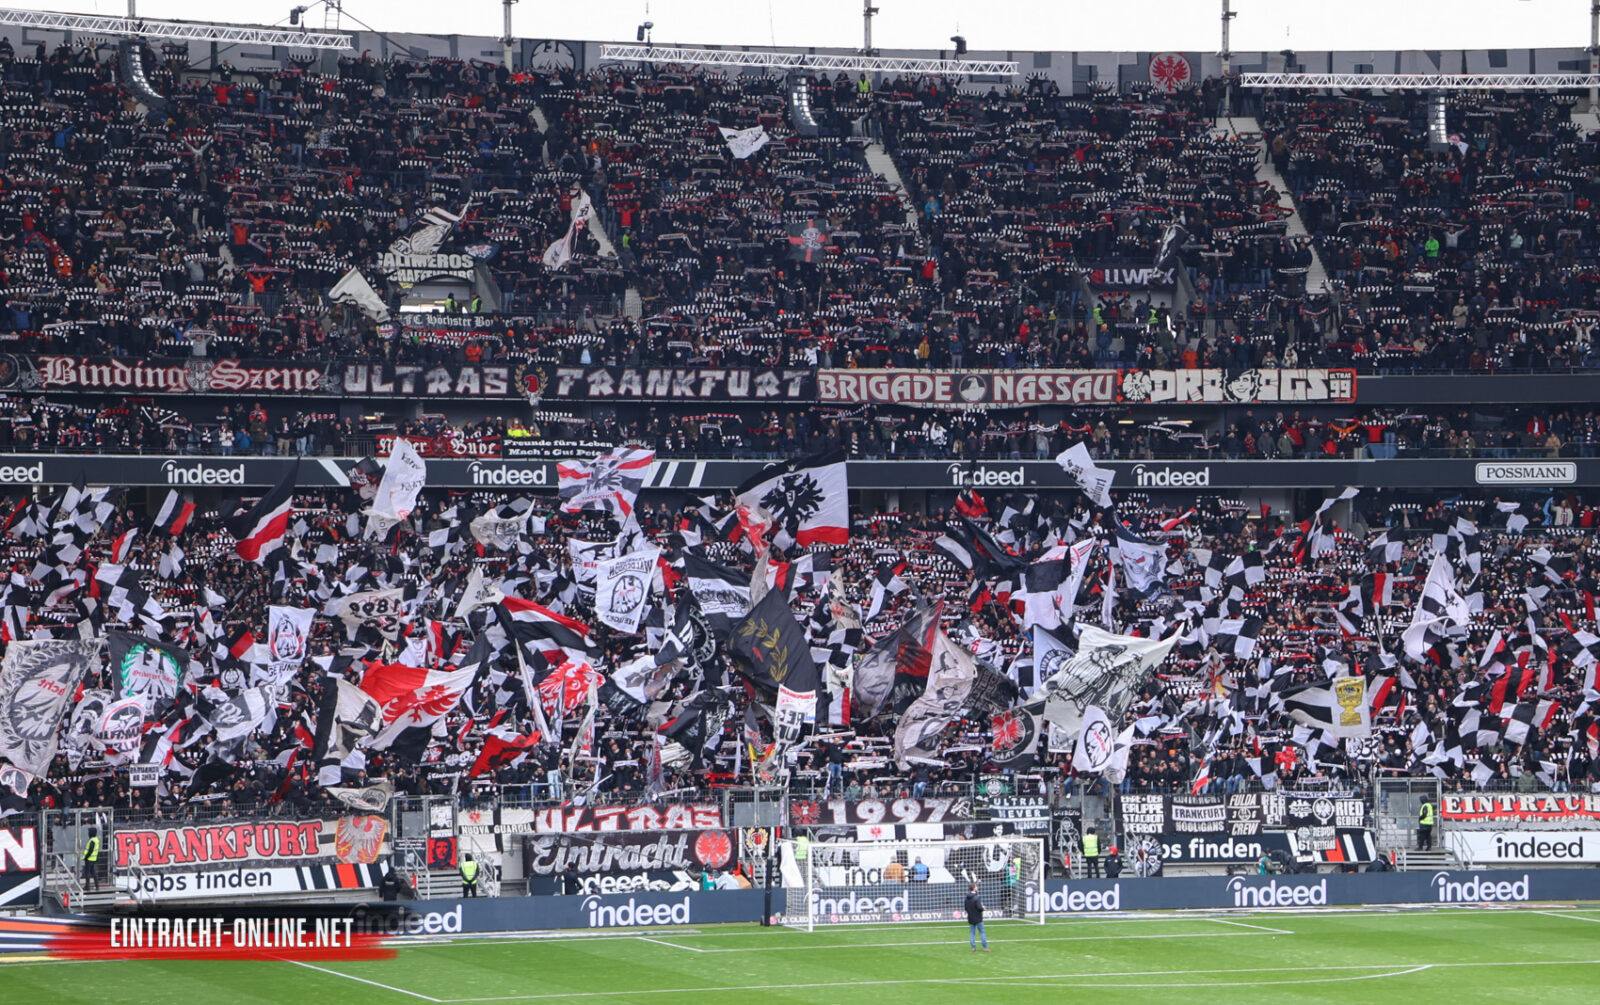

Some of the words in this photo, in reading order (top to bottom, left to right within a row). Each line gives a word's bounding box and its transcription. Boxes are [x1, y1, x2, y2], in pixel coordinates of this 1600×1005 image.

[38, 356, 191, 392] Binding
[209, 359, 321, 392] Szene
[344, 366, 509, 395] ULTRAS
[556, 366, 814, 397] FRANKFURT
[818, 374, 953, 402] BRIGADE
[993, 375, 1114, 402] NASSAU
[1330, 379, 1351, 398] 99
[503, 439, 551, 447] Freunde
[554, 438, 577, 447] fürs
[579, 440, 613, 448] Leben
[552, 448, 573, 456] Gut
[167, 464, 245, 484] indeed
[472, 465, 547, 485] indeed
[1136, 464, 1209, 486] indeed
[1486, 467, 1567, 479] POSSMANN
[994, 797, 1044, 806] ULTRAS
[1122, 803, 1164, 814] GRUPPE
[1230, 793, 1257, 806] FULDA
[1335, 801, 1364, 816] RIED
[535, 804, 722, 832] ULTRAS
[827, 800, 951, 825] 1997
[998, 809, 1042, 818] NEVER
[1174, 807, 1226, 819] FRANKFURT
[1336, 816, 1364, 826] GEBIET
[461, 825, 490, 835] NUOVA
[1176, 820, 1224, 832] HOOLIGANS
[1231, 822, 1258, 836] CREW
[114, 820, 323, 868] FRANKFURT
[531, 833, 693, 874] Eintracht
[1189, 837, 1262, 859] finden
[1496, 836, 1584, 859] indeed
[195, 867, 272, 890] finden
[1438, 874, 1530, 902] indeed
[811, 889, 909, 915] indeed
[1025, 883, 1120, 912] indeed
[1233, 878, 1327, 907] indeed
[588, 896, 691, 928] indeed
